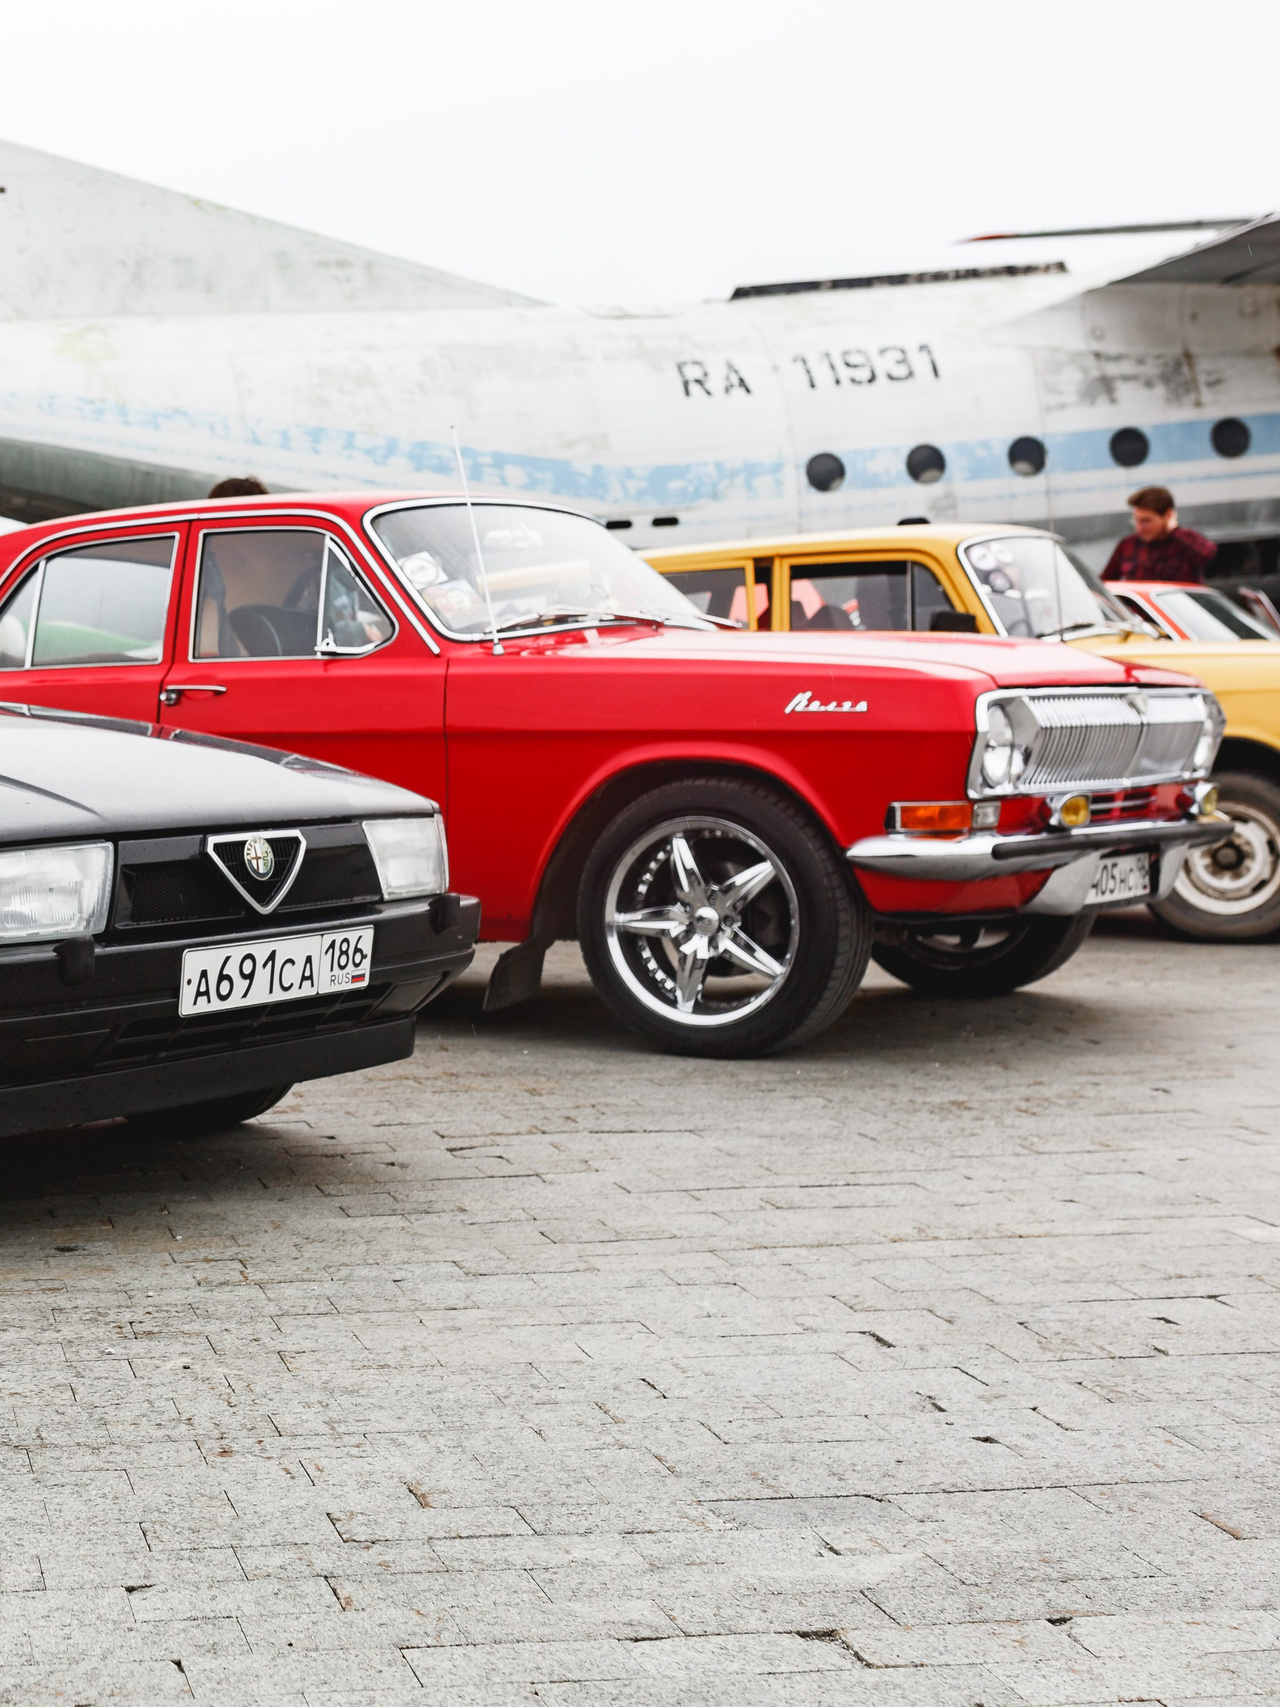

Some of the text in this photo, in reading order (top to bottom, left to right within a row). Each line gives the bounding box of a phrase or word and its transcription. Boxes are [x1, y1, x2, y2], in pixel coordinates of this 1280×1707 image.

[676, 344, 940, 398] RA 11931
[192, 935, 364, 1006] A691CA 186
[329, 972, 351, 987] RUS
